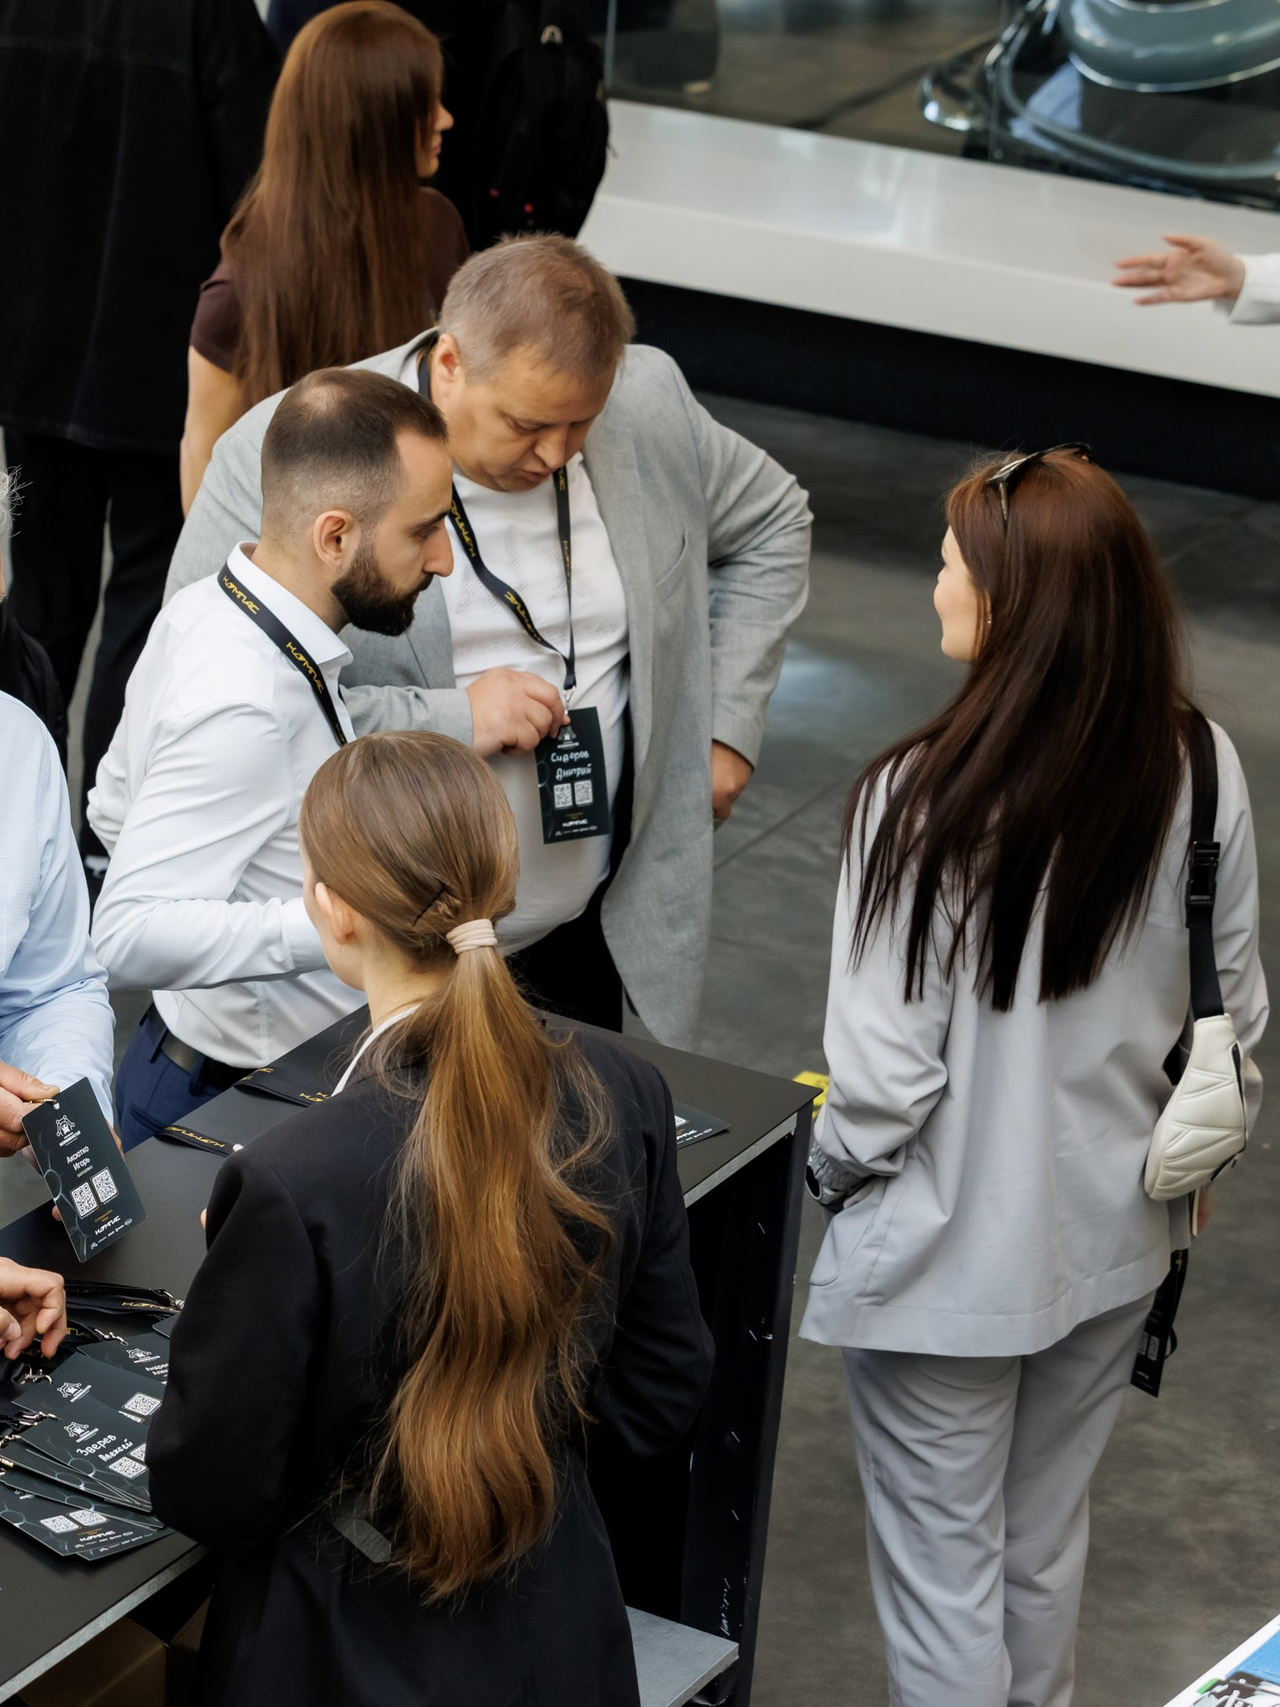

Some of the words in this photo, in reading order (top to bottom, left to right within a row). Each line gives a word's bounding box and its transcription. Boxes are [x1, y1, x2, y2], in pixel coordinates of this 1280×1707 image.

[222, 575, 260, 615] КОМПАС
[285, 641, 324, 694] КОМПАС
[555, 763, 592, 781] Дмитрий
[73, 1157, 91, 1172] Игорь
[76, 1434, 117, 1456] Зверев
[98, 1438, 133, 1462] Алексей
